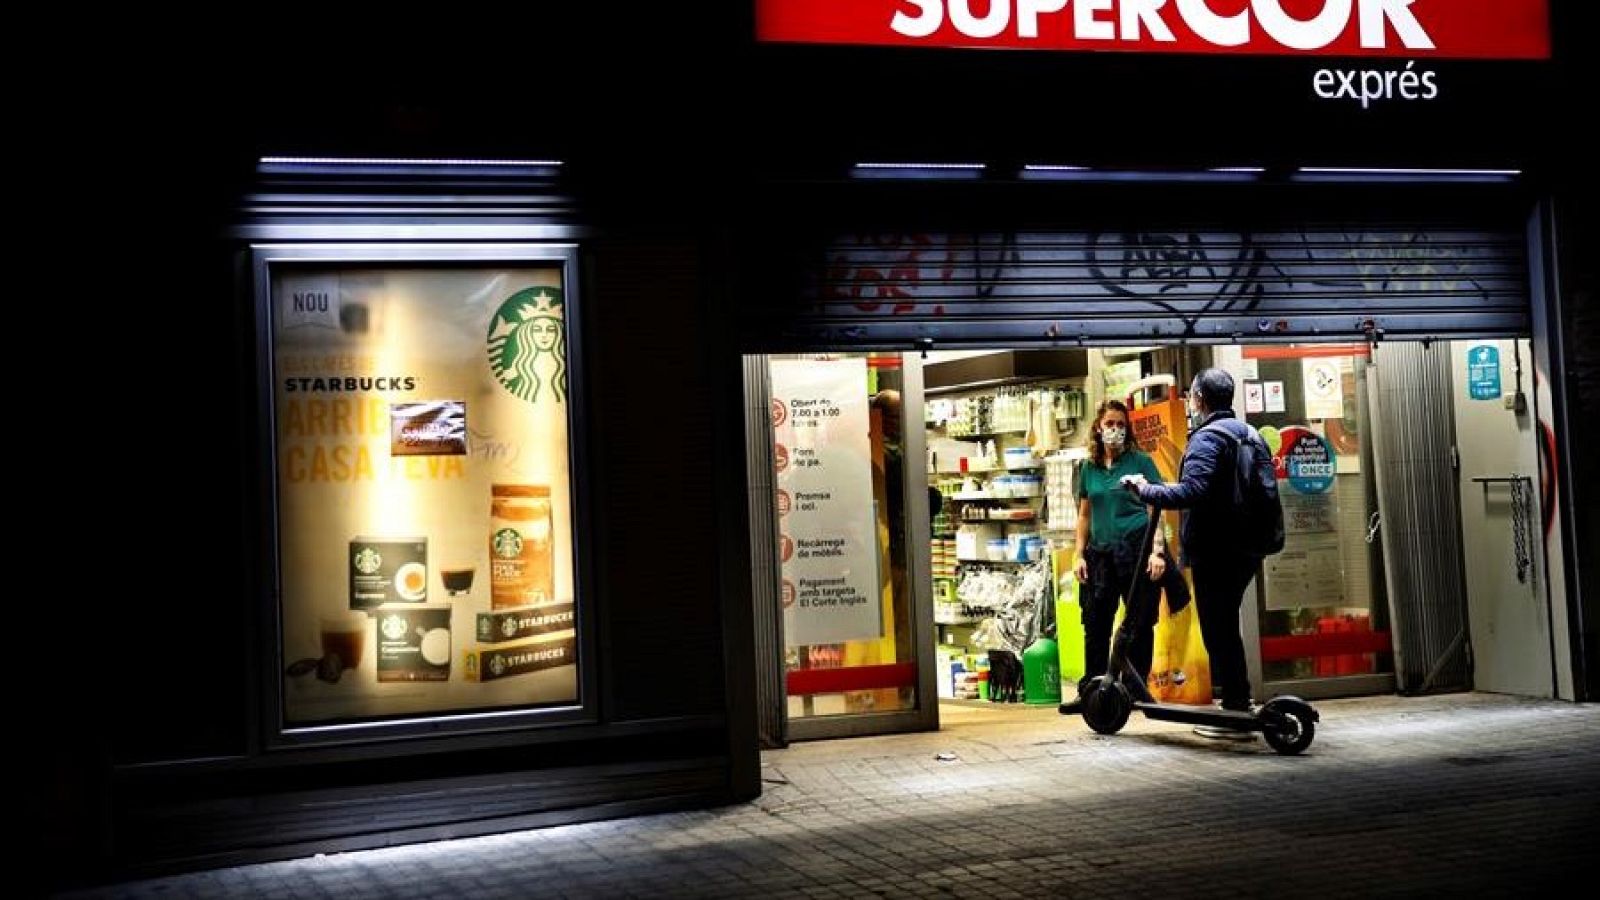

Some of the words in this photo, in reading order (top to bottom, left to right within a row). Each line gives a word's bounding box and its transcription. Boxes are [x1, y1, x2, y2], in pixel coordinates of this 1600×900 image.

[1313, 60, 1438, 108] exprés
[292, 292, 329, 313] NOU
[284, 376, 416, 393] STARBUCKS
[790, 399, 817, 408] Obert
[822, 408, 840, 417] 1.00
[287, 443, 374, 483] CASA
[1300, 464, 1331, 474] ONCE
[795, 492, 831, 501] Premsa
[801, 502, 818, 511] oci.
[797, 539, 846, 550] Recàrrega
[797, 549, 809, 559] de
[799, 577, 846, 589] Pagament
[799, 588, 820, 598] amb
[822, 586, 856, 597] targeta
[799, 598, 810, 608] El
[812, 597, 838, 607] Corte
[508, 648, 565, 668] STARBUCKS
